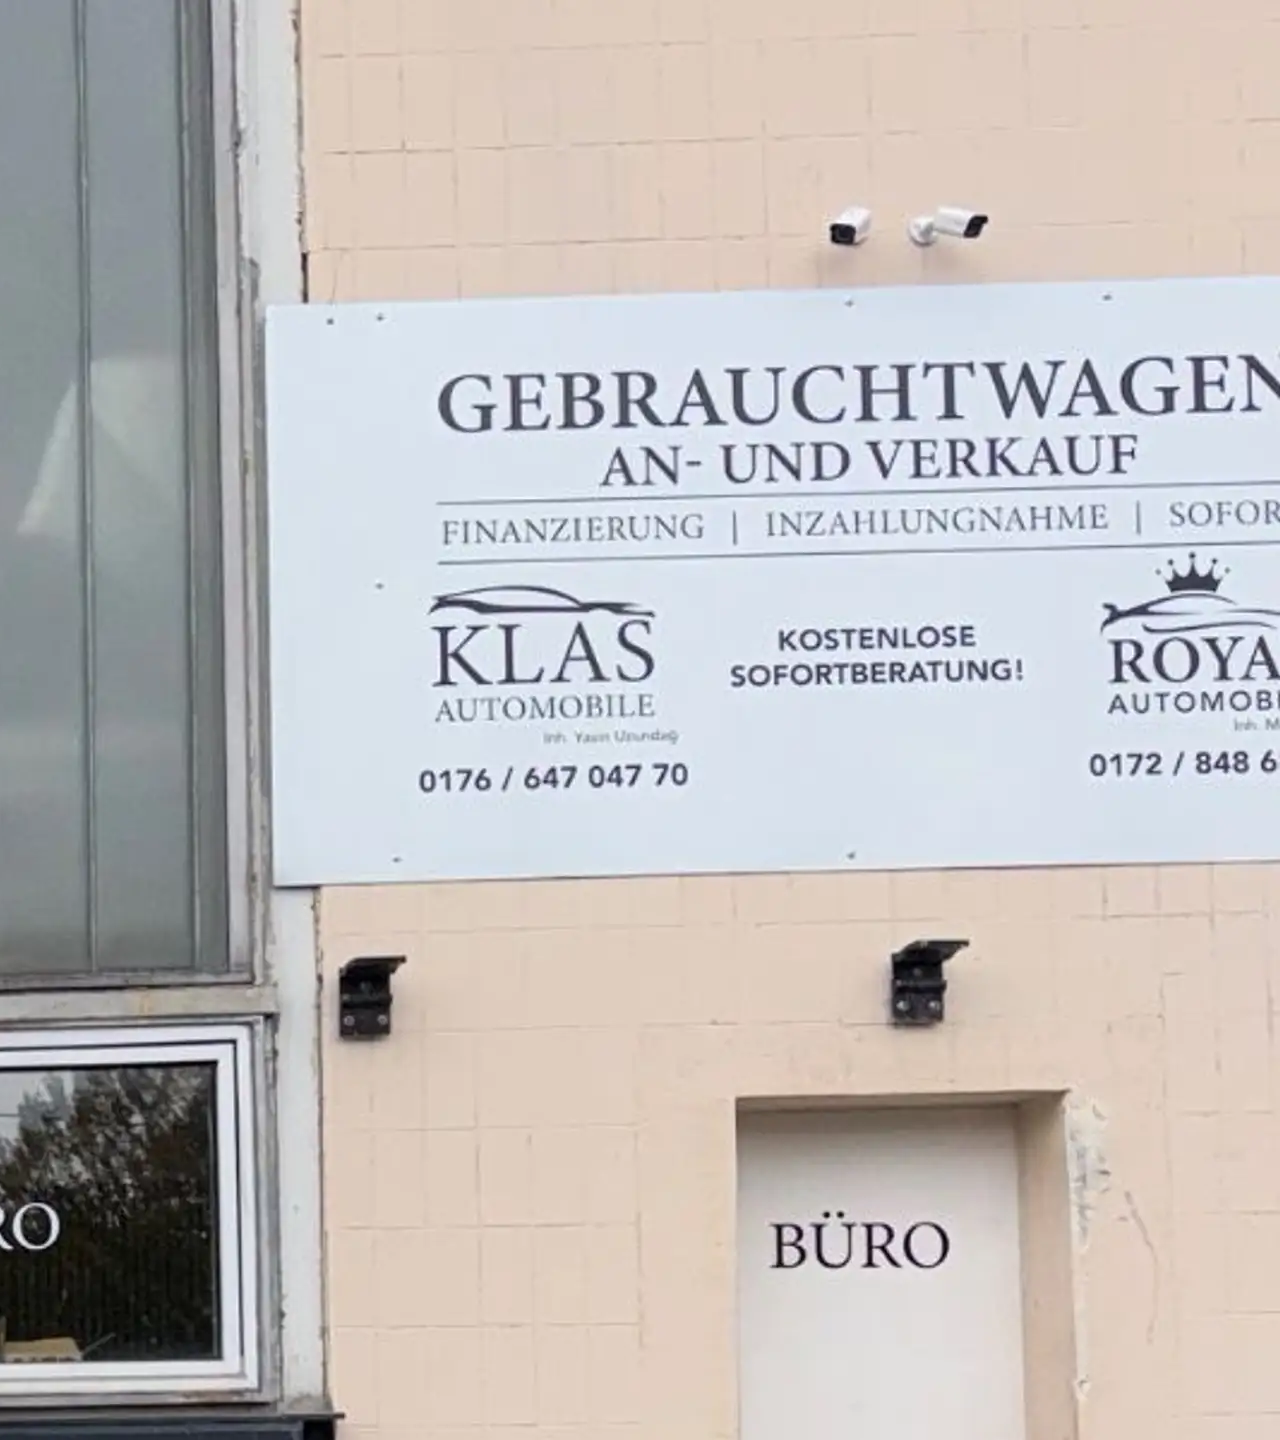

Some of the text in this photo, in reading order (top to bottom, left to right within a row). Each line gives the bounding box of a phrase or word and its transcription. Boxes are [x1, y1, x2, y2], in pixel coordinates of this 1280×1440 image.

[438, 353, 1280, 434] GEBRAUCHTWAGEN
[599, 433, 1139, 488] AN- UND VERKAUF
[442, 513, 705, 546] FINANZIERUNG
[766, 503, 1109, 538] INZAHLUNGNAHME
[430, 618, 656, 688] KLAS
[777, 625, 976, 653] KOSTENLOSE
[1107, 634, 1280, 684] ROYA
[729, 658, 1024, 688] SOFORTBERATUNG!
[435, 694, 656, 723] AUTOMOBILE
[418, 761, 690, 794] 0176 / 647 047 70
[1089, 752, 1163, 777] 0172
[1171, 751, 1186, 777] /
[1194, 750, 1251, 775] 848
[768, 1210, 952, 1270] BÜRO
